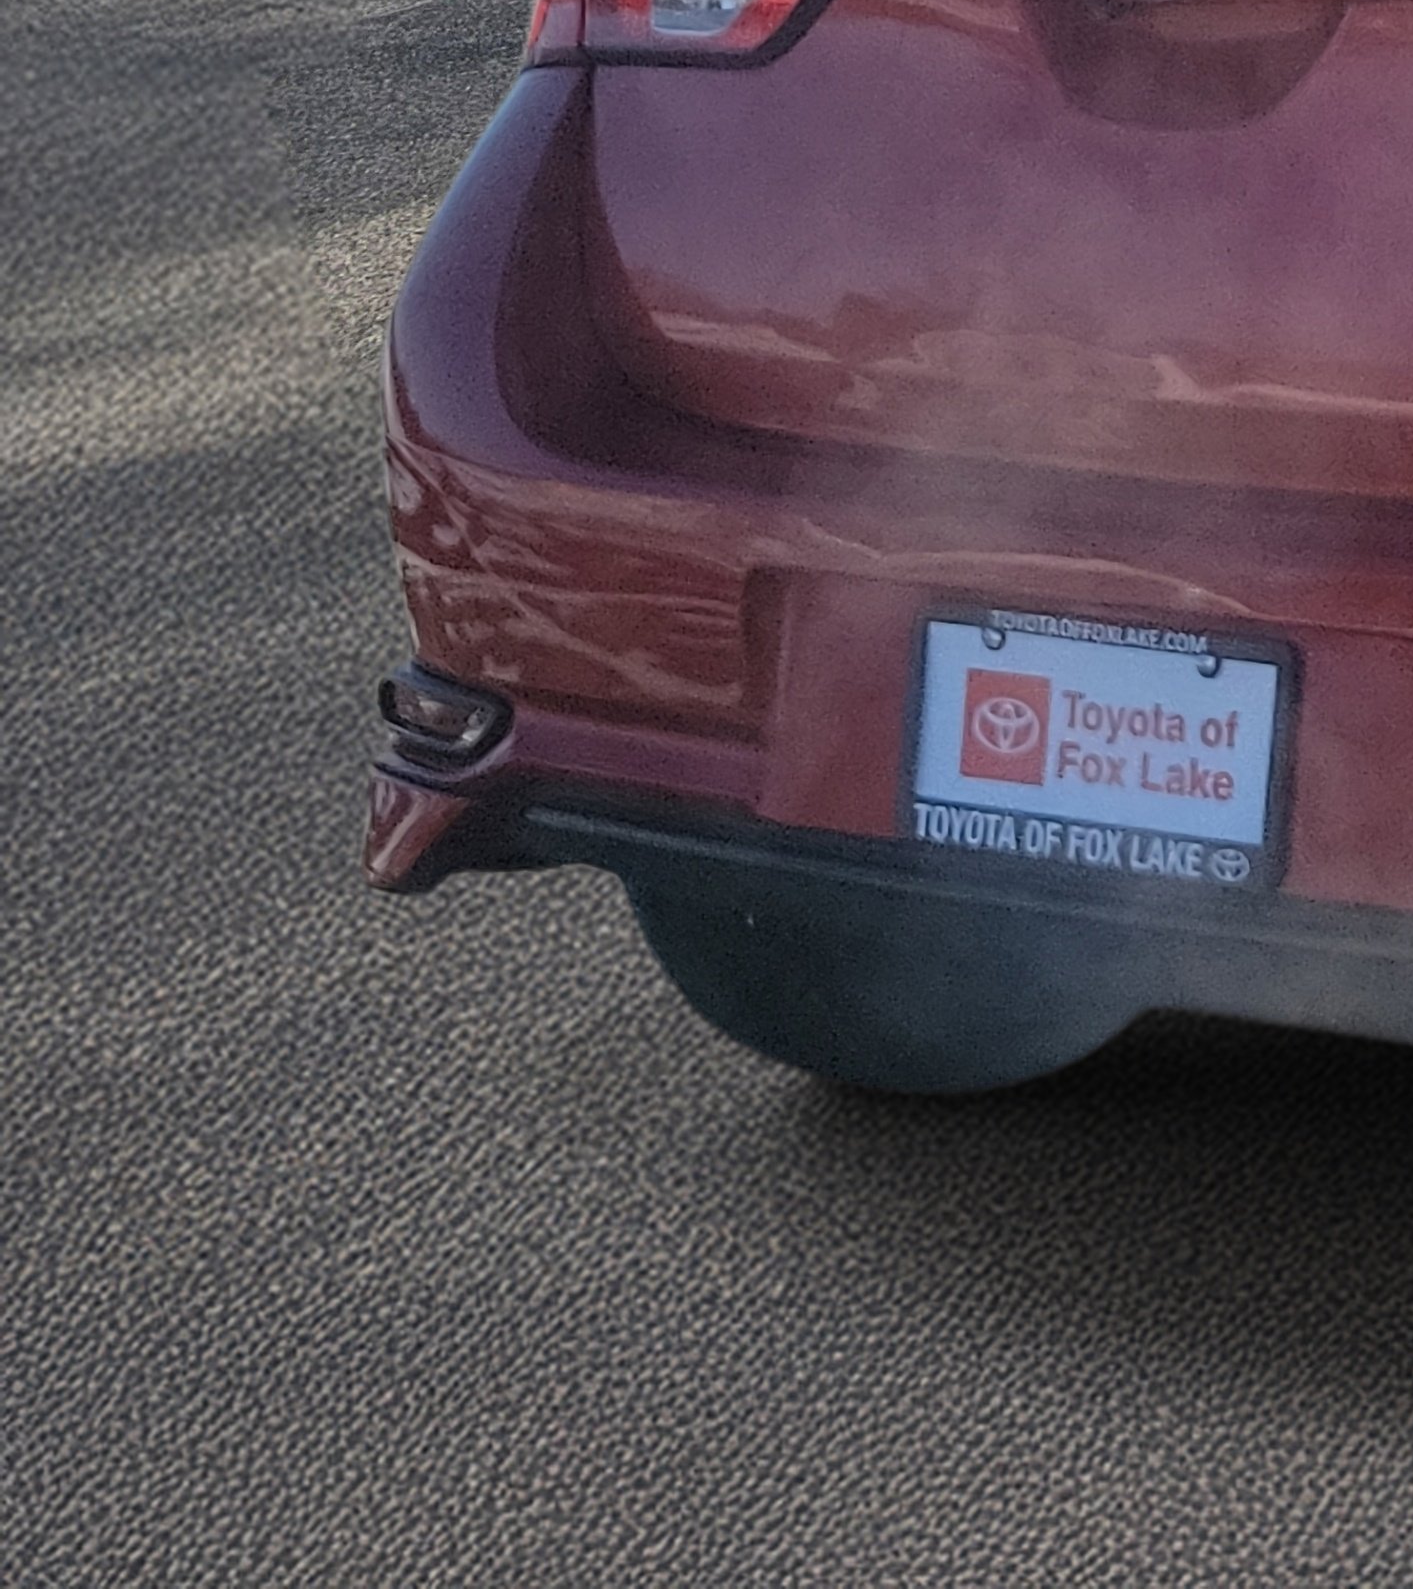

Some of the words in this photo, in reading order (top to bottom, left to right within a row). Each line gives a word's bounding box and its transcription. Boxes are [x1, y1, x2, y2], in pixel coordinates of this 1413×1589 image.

[1061, 689, 1186, 744] Toyota
[1199, 710, 1239, 749] of
[1058, 740, 1127, 788] Fox
[1140, 752, 1235, 801] Lake
[914, 803, 1017, 851] TOYOTA
[1024, 821, 1062, 859] OF
[1067, 826, 1124, 869] FOX
[1130, 835, 1205, 878] LAKE
